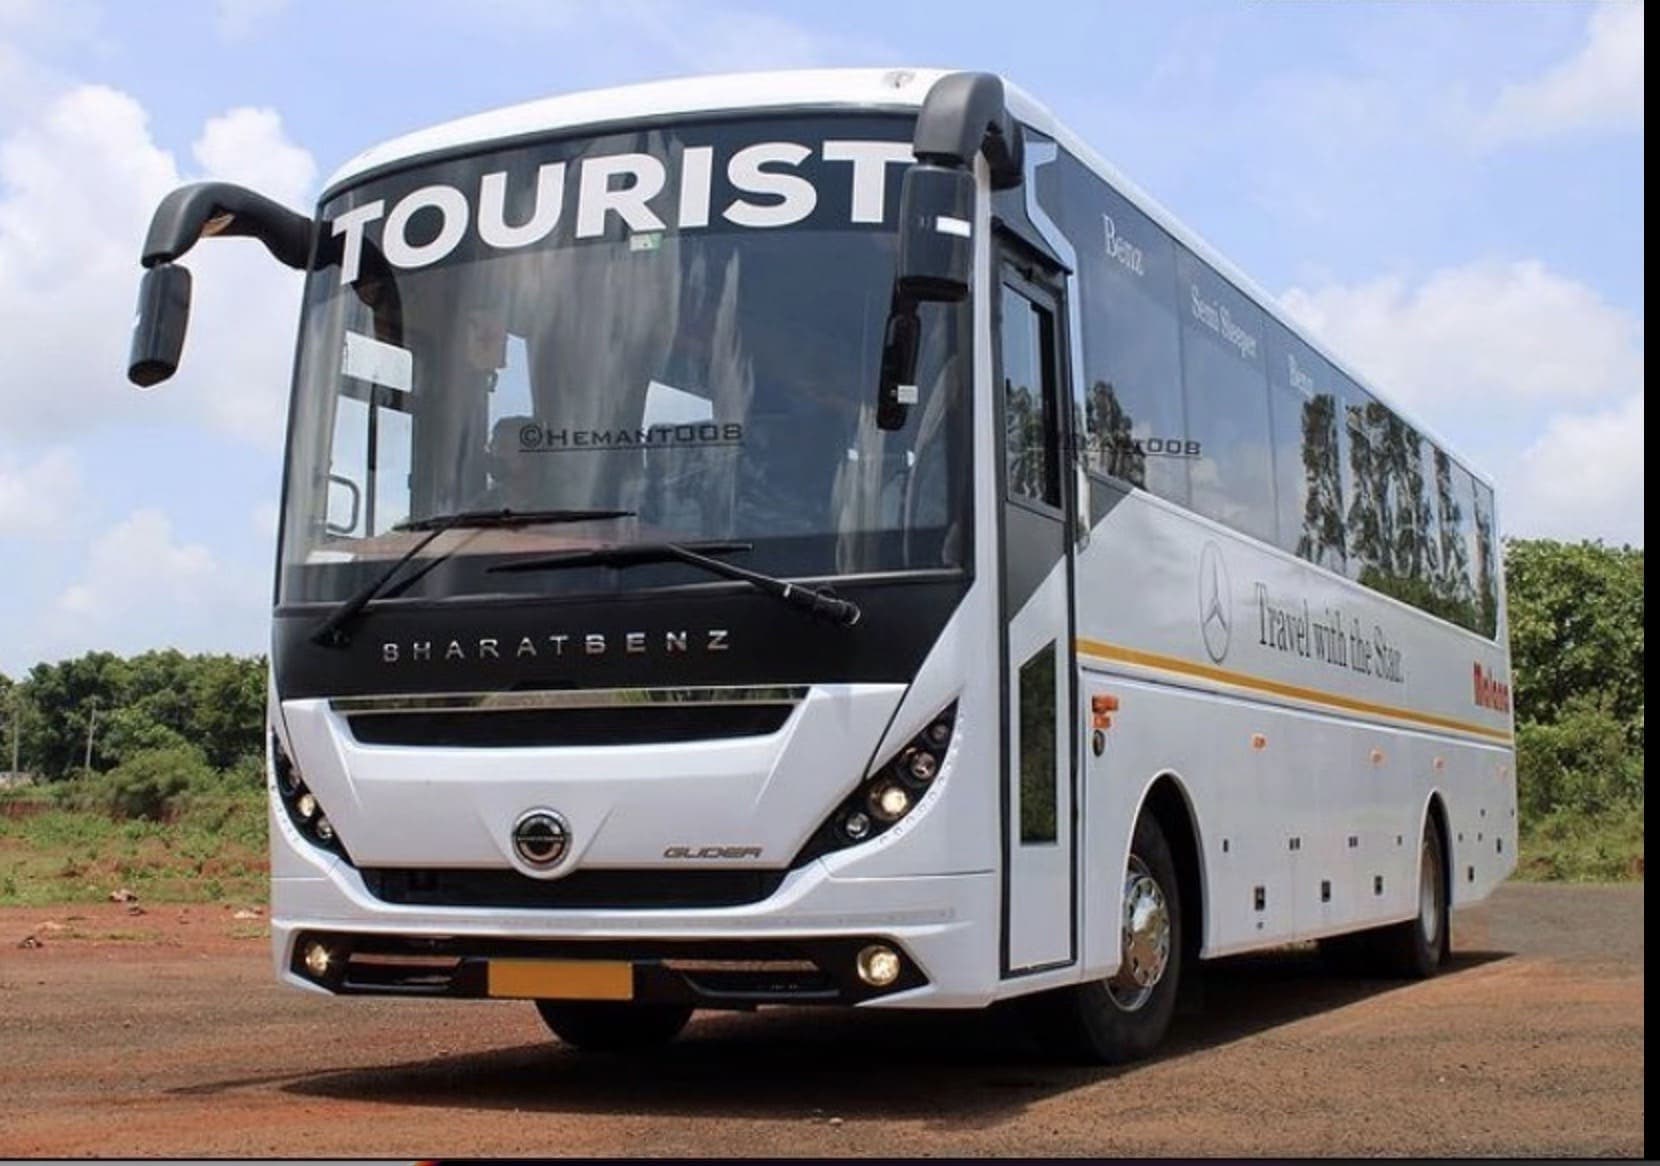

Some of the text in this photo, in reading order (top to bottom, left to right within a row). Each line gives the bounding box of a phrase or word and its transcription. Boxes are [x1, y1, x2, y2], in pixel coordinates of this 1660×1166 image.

[331, 139, 919, 286] TOURIST
[1102, 212, 1144, 276] Benz
[1191, 285, 1220, 333] Semi
[382, 629, 730, 663] BHARATBENZ
[1255, 581, 1310, 658] Travel
[1312, 607, 1347, 667] with
